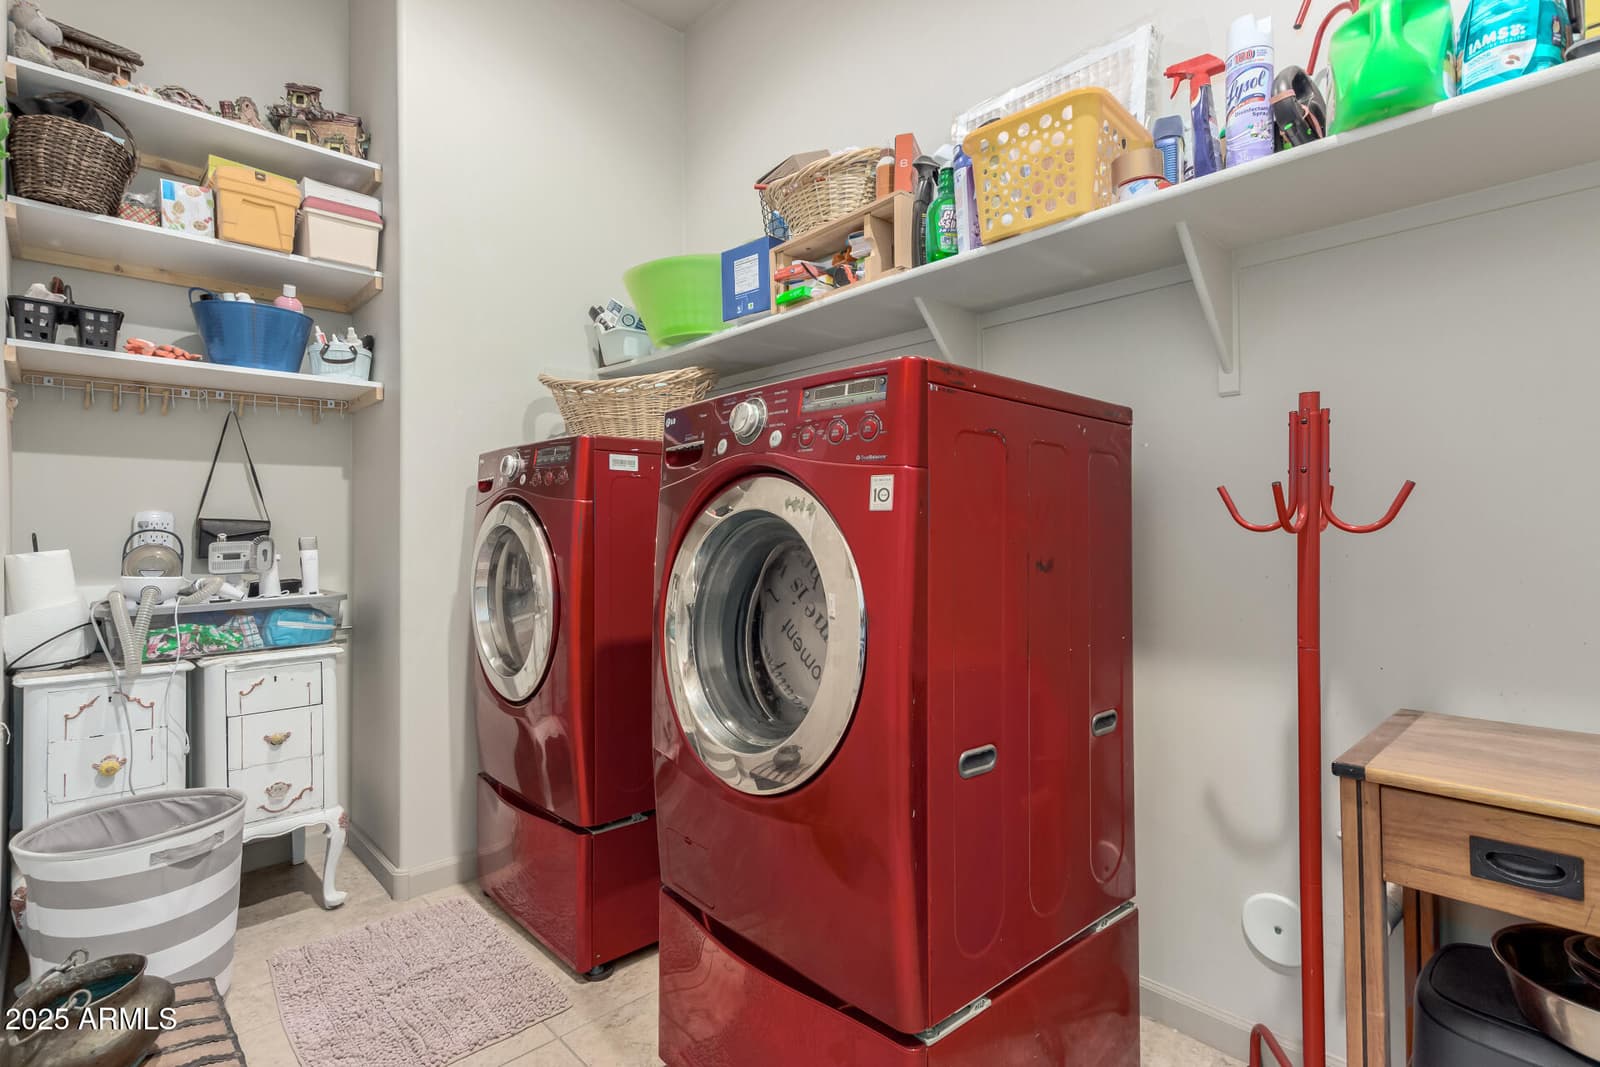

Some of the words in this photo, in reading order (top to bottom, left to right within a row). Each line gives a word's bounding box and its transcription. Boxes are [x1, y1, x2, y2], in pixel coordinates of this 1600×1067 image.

[1468, 26, 1508, 55] IAMS
[1227, 69, 1266, 107] Lysol
[873, 487, 890, 503] 10
[782, 618, 822, 680] oment
